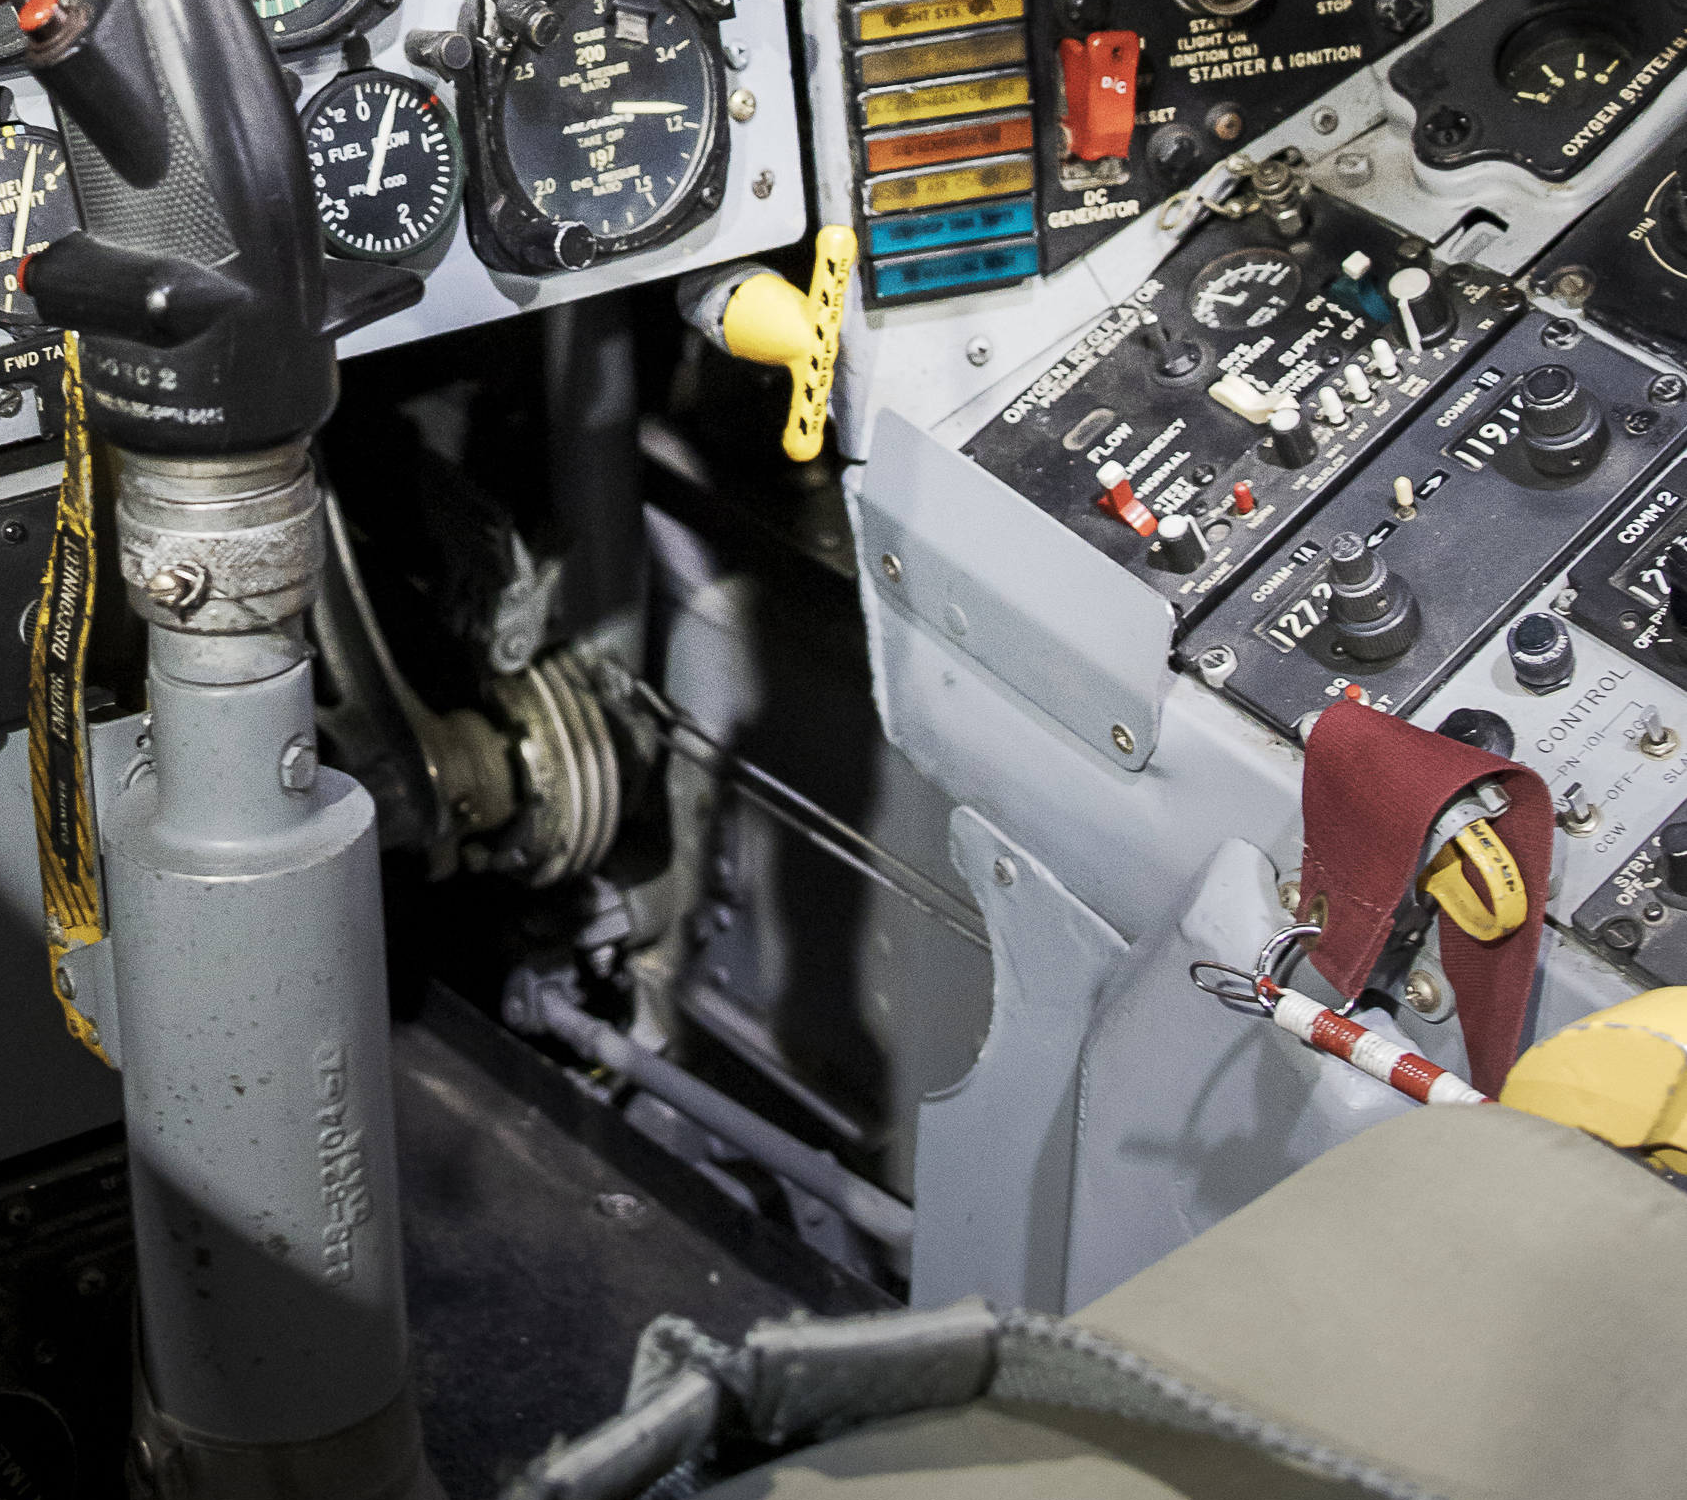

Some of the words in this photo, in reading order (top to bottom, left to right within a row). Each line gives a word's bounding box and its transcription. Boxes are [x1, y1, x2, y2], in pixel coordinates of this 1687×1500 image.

[1317, 0, 1353, 15] STOP
[1169, 47, 1229, 68] IGNITION
[1189, 58, 1266, 84] STARTER
[1289, 45, 1362, 69] IGNITION
[1562, 101, 1623, 158] OXYGEN
[1619, 45, 1677, 102] SYSTEM
[328, 142, 367, 163] FUEL
[1083, 189, 1109, 206] DC
[1048, 200, 1141, 228] GENERATOR
[1628, 216, 1656, 242] DIM
[1278, 316, 1335, 367] SUPPLY
[4, 352, 39, 372] FWD
[1003, 364, 1070, 424] OXYGEN
[1086, 422, 1134, 464] FLOW
[1139, 450, 1191, 496] NORMAL
[1617, 502, 1666, 544] COMM
[1656, 491, 1679, 507] 2
[1195, 562, 1234, 594] VOLUME
[51, 536, 81, 662] DISCONNECT
[1633, 624, 1660, 650] OFF
[1535, 667, 1633, 755] CONTROL
[1606, 771, 1633, 802] OFF
[1594, 821, 1628, 854] CCW
[1613, 851, 1653, 889] STBY
[1615, 875, 1646, 907] OFF
